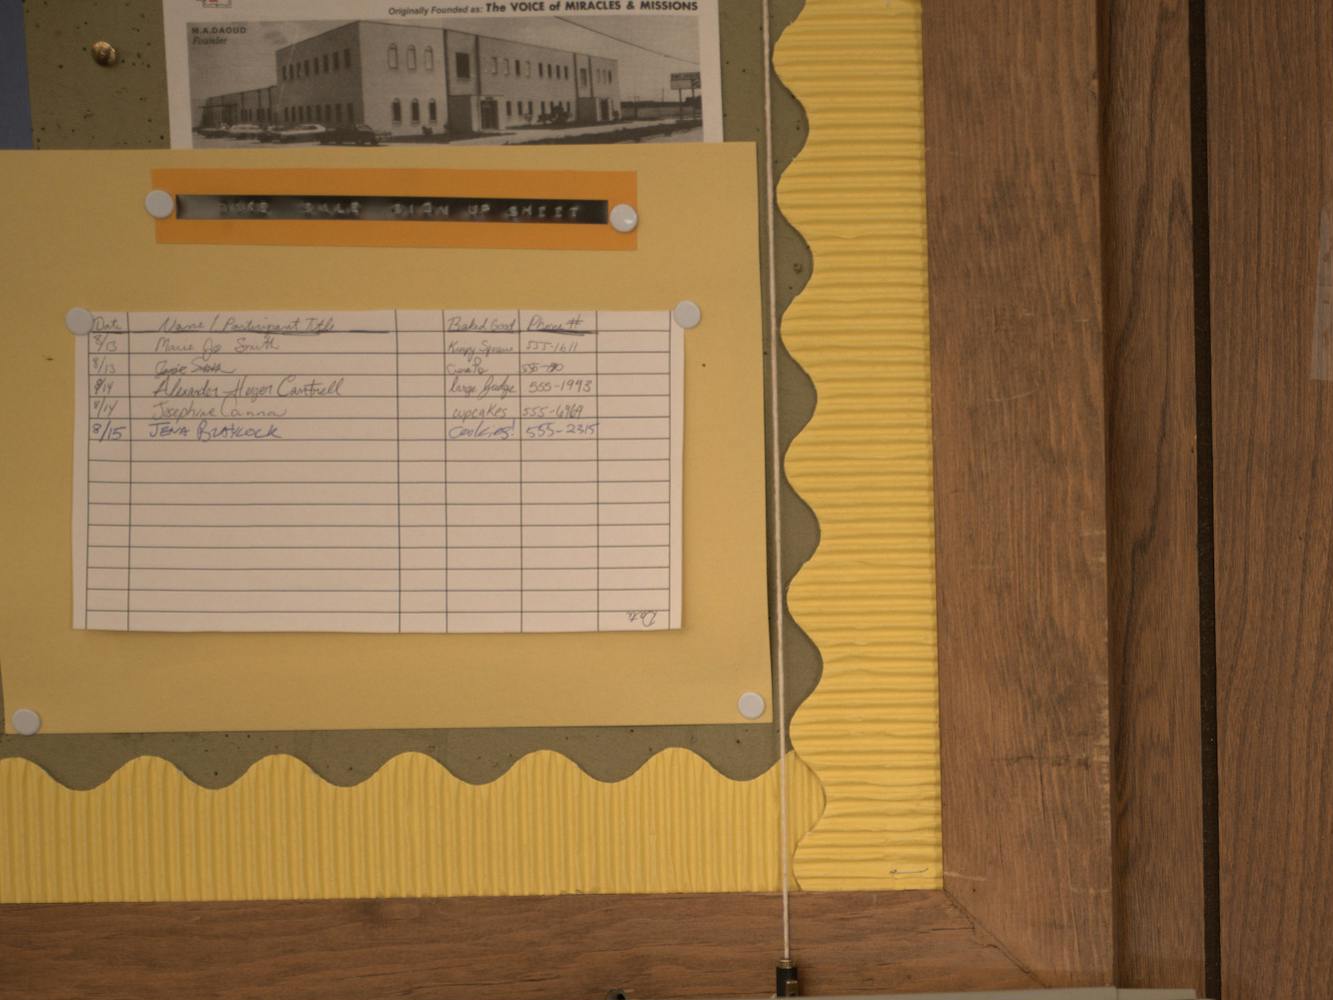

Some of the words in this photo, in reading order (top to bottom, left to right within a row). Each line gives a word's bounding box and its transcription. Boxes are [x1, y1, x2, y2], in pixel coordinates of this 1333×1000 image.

[388, 6, 428, 17] Originally
[431, 5, 465, 16] Founded
[486, 1, 507, 12] The
[511, 1, 547, 12] VOICE
[549, 0, 561, 12] of
[565, 0, 621, 11] MIRACLES
[626, 0, 635, 10] &
[640, 0, 699, 11] MISSIONS
[467, 202, 491, 217] UP
[92, 420, 127, 442] 8/15
